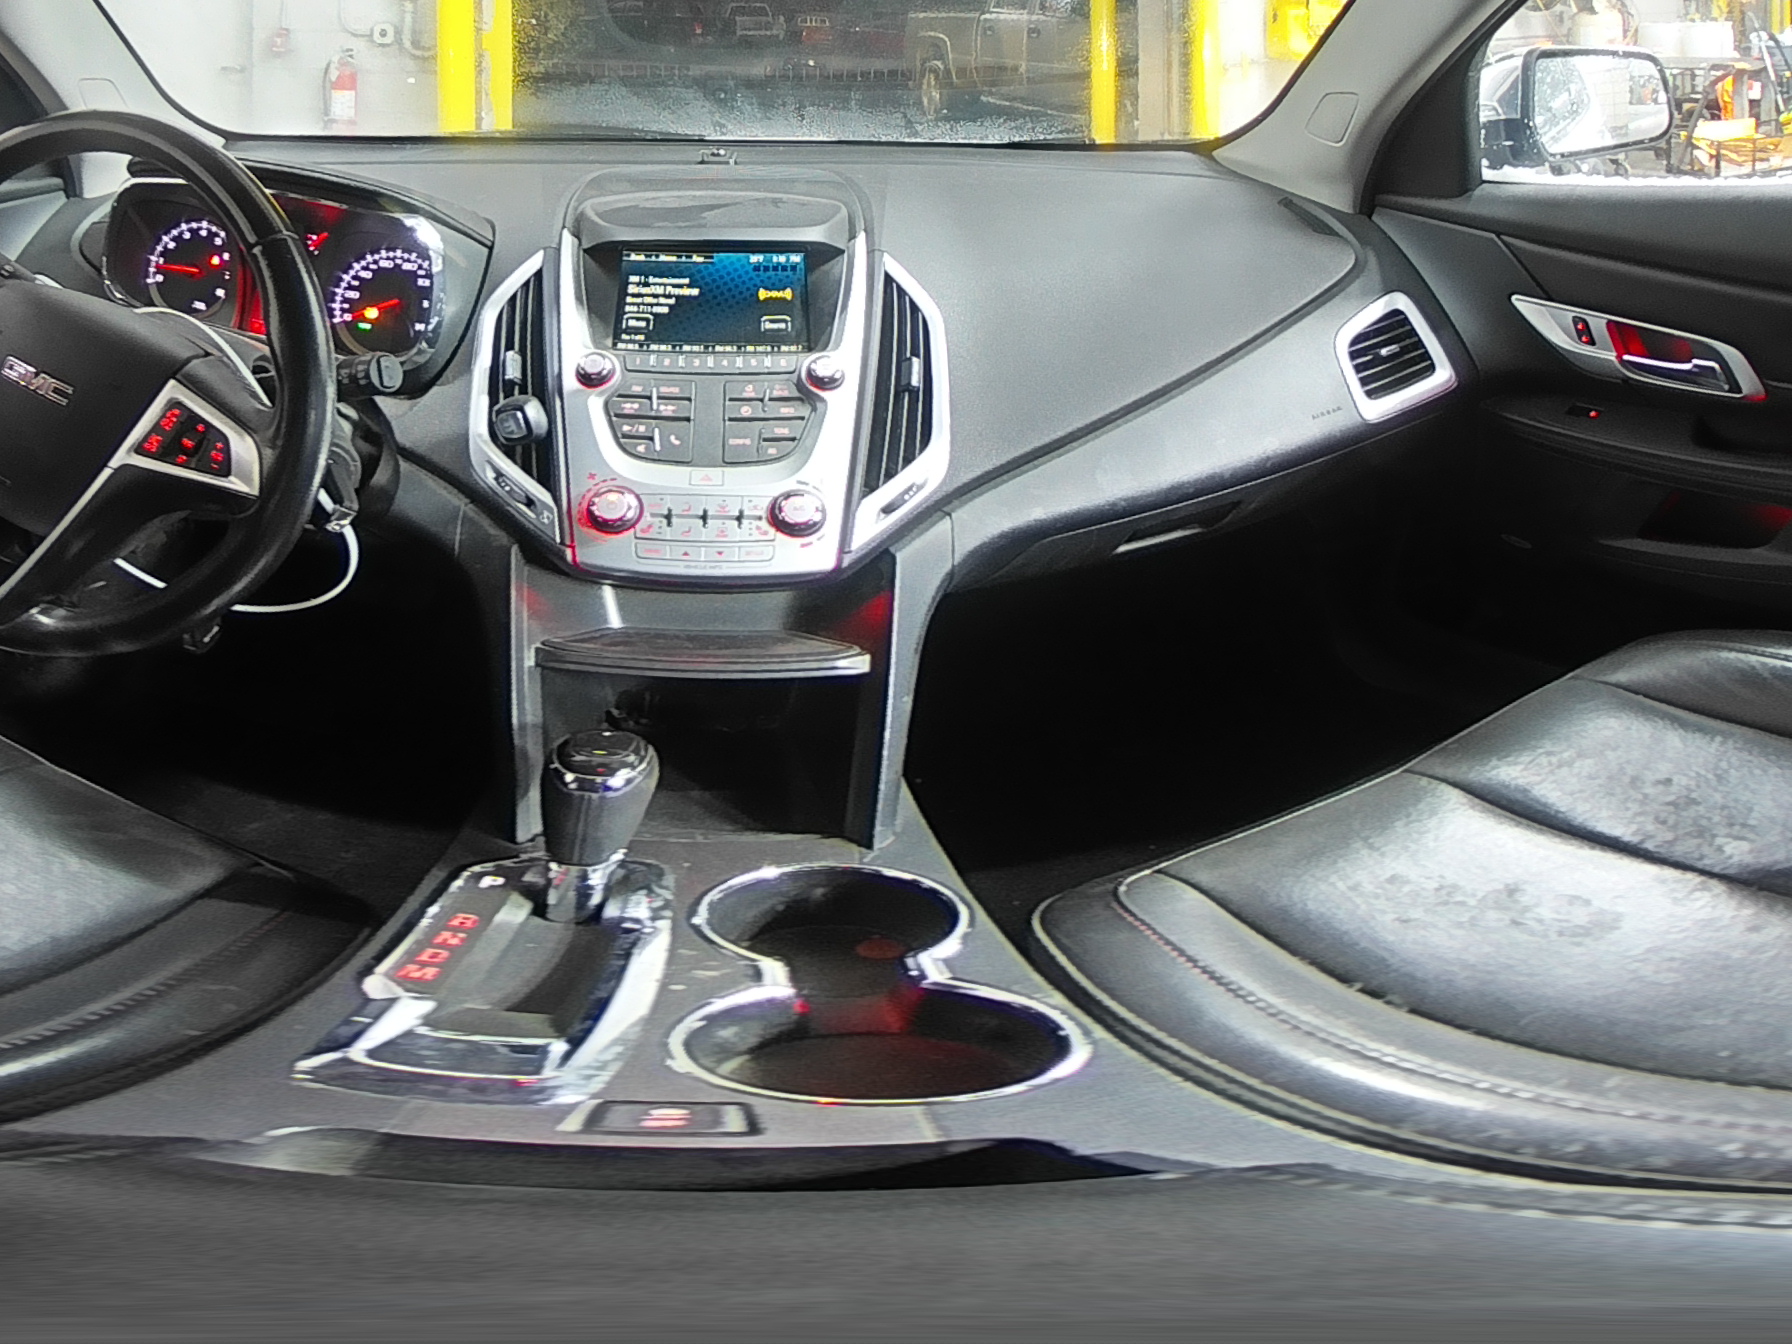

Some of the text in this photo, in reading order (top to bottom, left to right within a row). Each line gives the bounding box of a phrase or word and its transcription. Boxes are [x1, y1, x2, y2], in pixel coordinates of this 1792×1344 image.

[182, 232, 191, 240] 3
[214, 237, 223, 246] 5
[379, 260, 394, 268] 60
[155, 274, 164, 283] 0
[344, 290, 360, 299] 20
[626, 284, 700, 296] SiriusXM Preview
[0, 355, 75, 407] GMC
[478, 875, 506, 889] P
[414, 948, 452, 965] D
[394, 964, 443, 982] M
